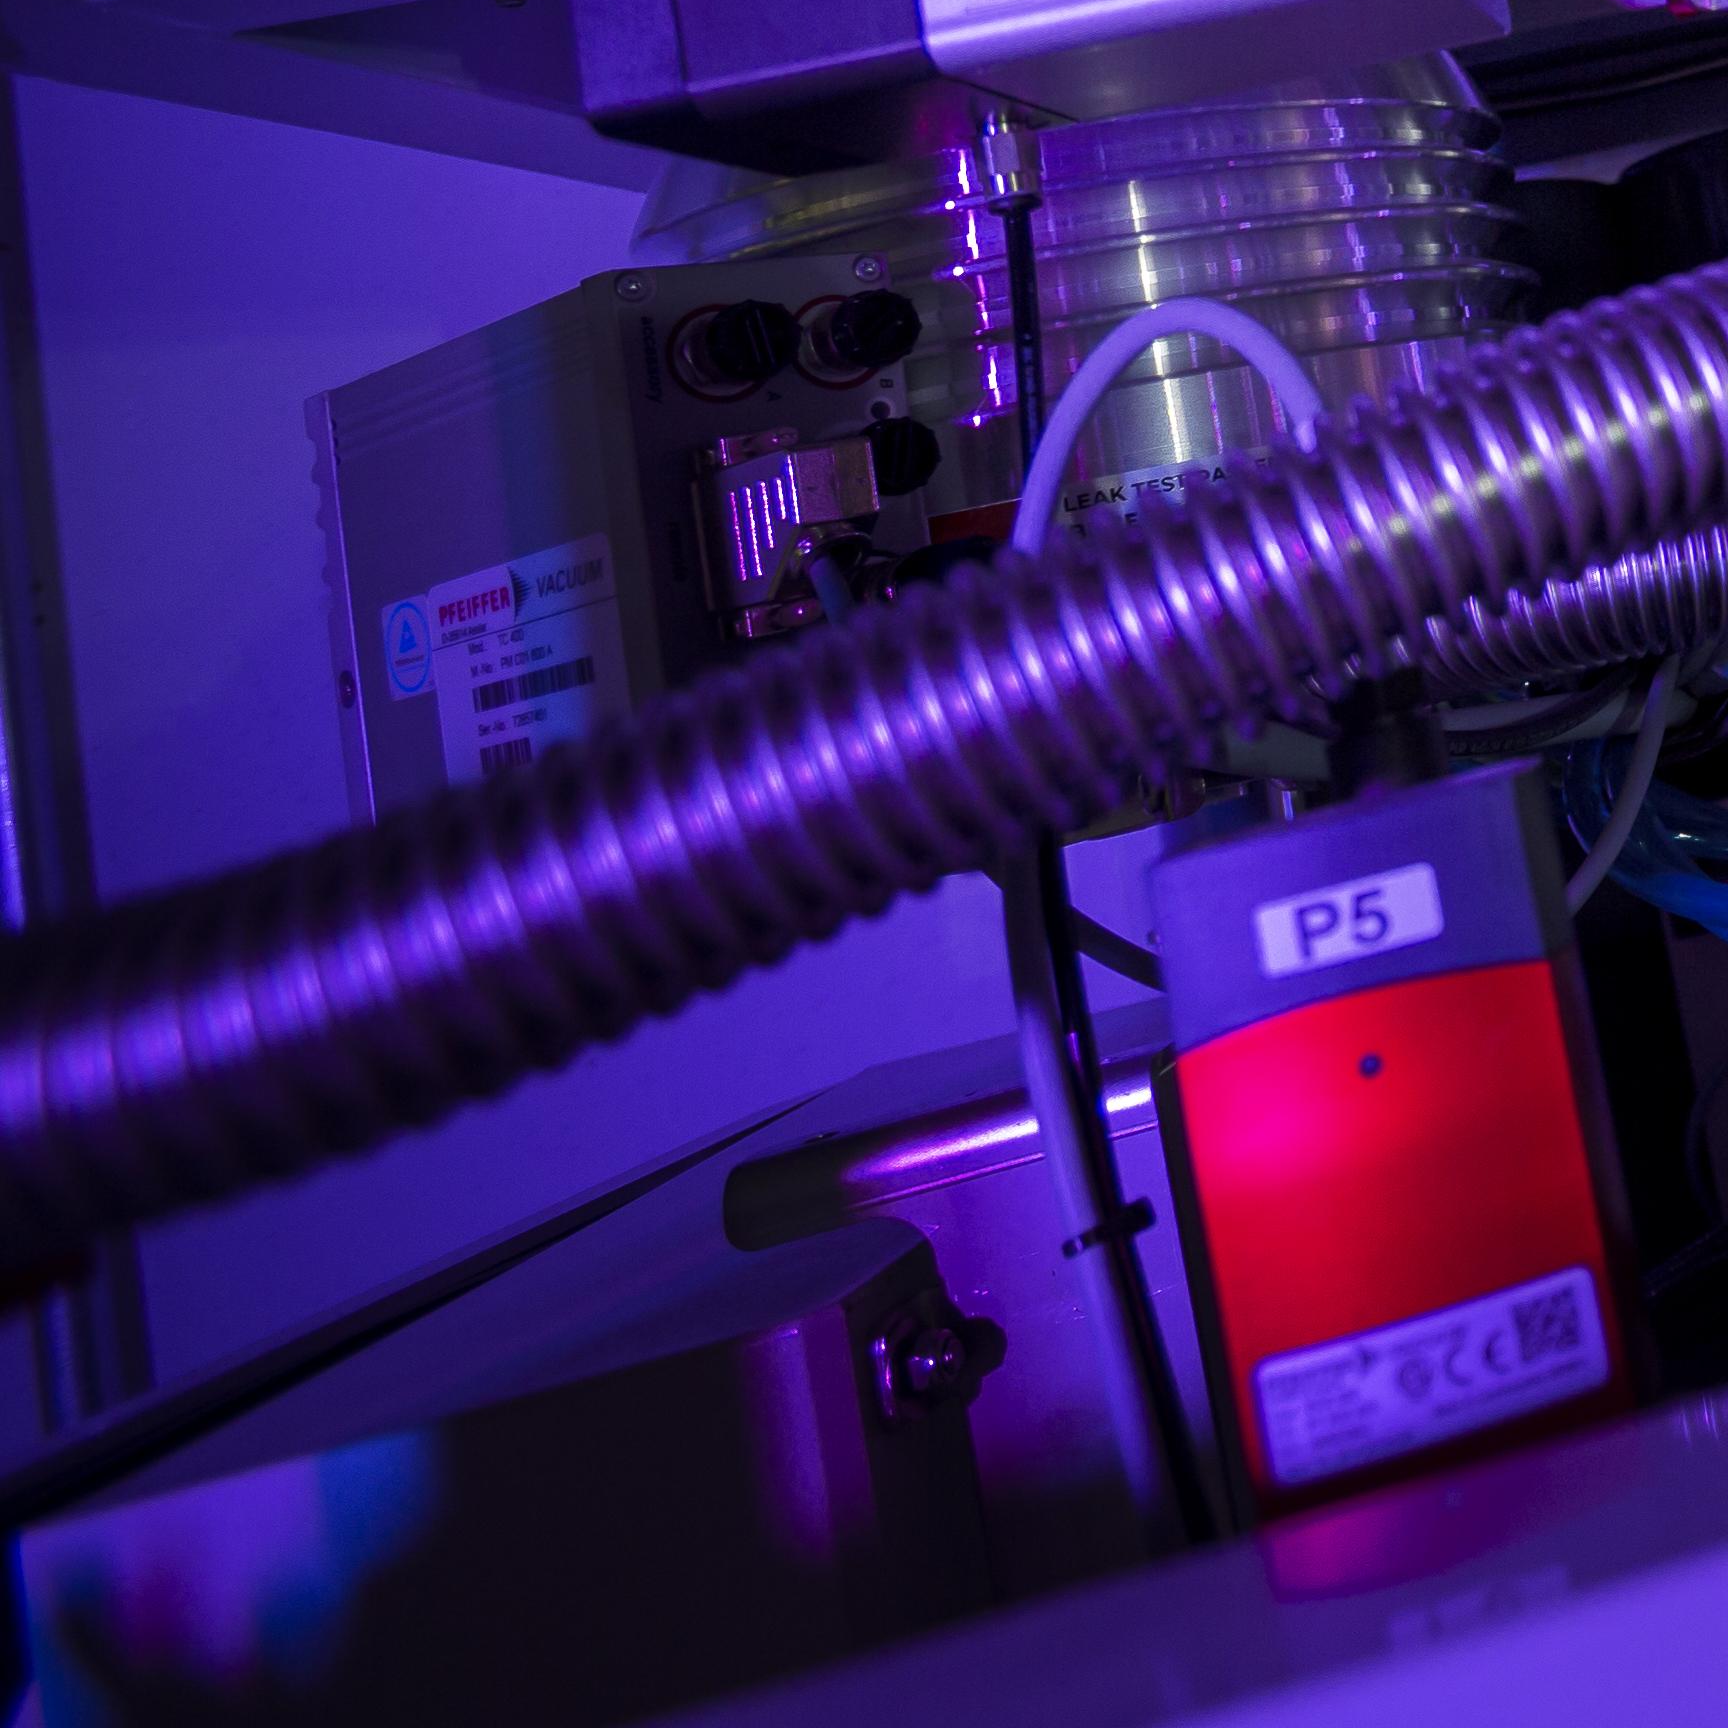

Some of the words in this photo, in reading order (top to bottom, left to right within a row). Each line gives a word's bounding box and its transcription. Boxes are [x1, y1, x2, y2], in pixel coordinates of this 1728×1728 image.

[1063, 485, 1127, 513] LEAK
[1131, 472, 1187, 496] TEST
[438, 586, 511, 627] PFEIFFER
[536, 558, 604, 598] VACUUM
[1296, 888, 1389, 958] P5
